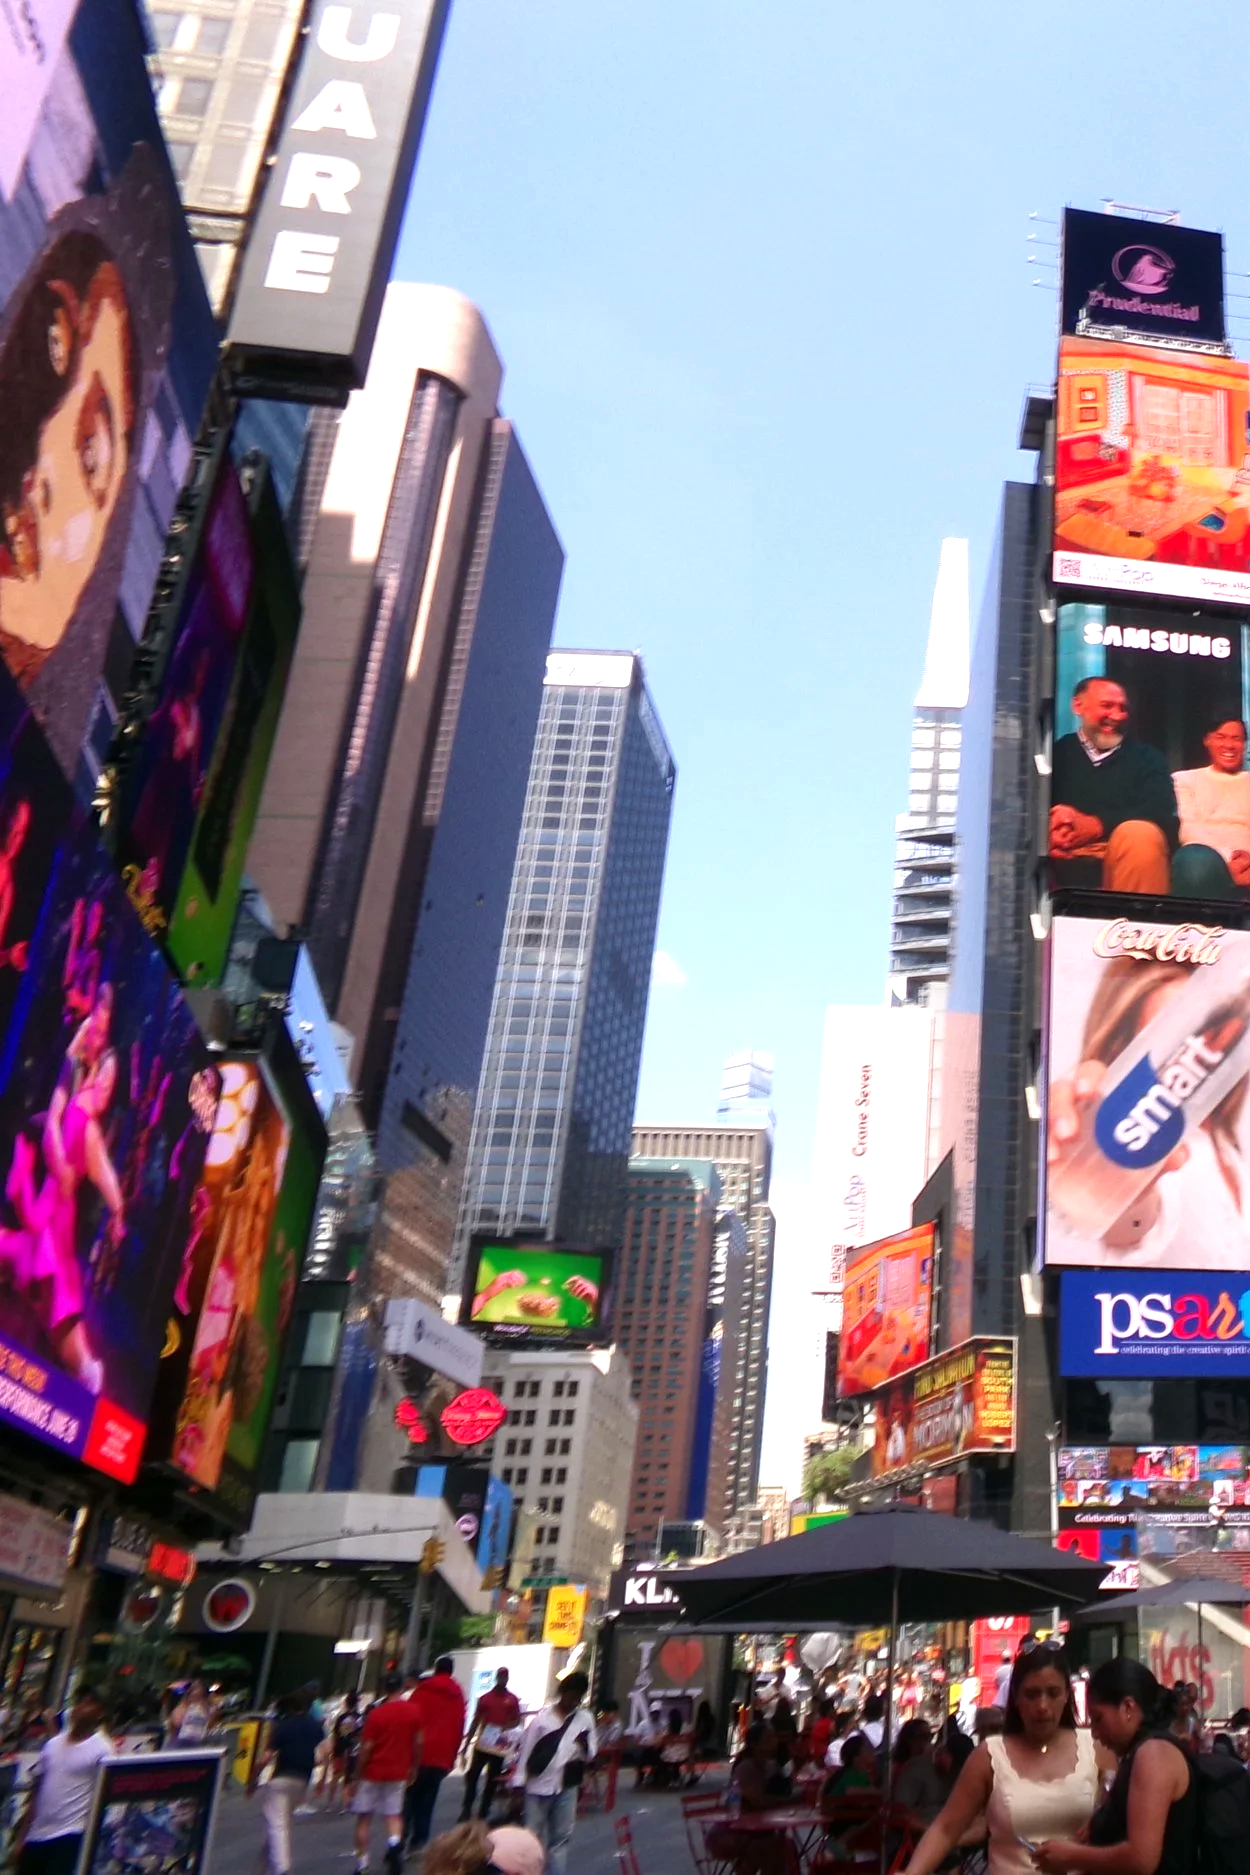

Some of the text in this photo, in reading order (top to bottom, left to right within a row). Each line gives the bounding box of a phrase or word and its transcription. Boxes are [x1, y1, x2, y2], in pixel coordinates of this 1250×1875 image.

[1088, 288, 1200, 322] Prudential
[1083, 622, 1231, 659] SAMSUNG
[1093, 918, 1227, 966] Coca-Cola
[852, 1063, 872, 1157] Crane Seven
[1112, 1034, 1224, 1152] smart
[1074, 1513, 1127, 1524] Celebrating
